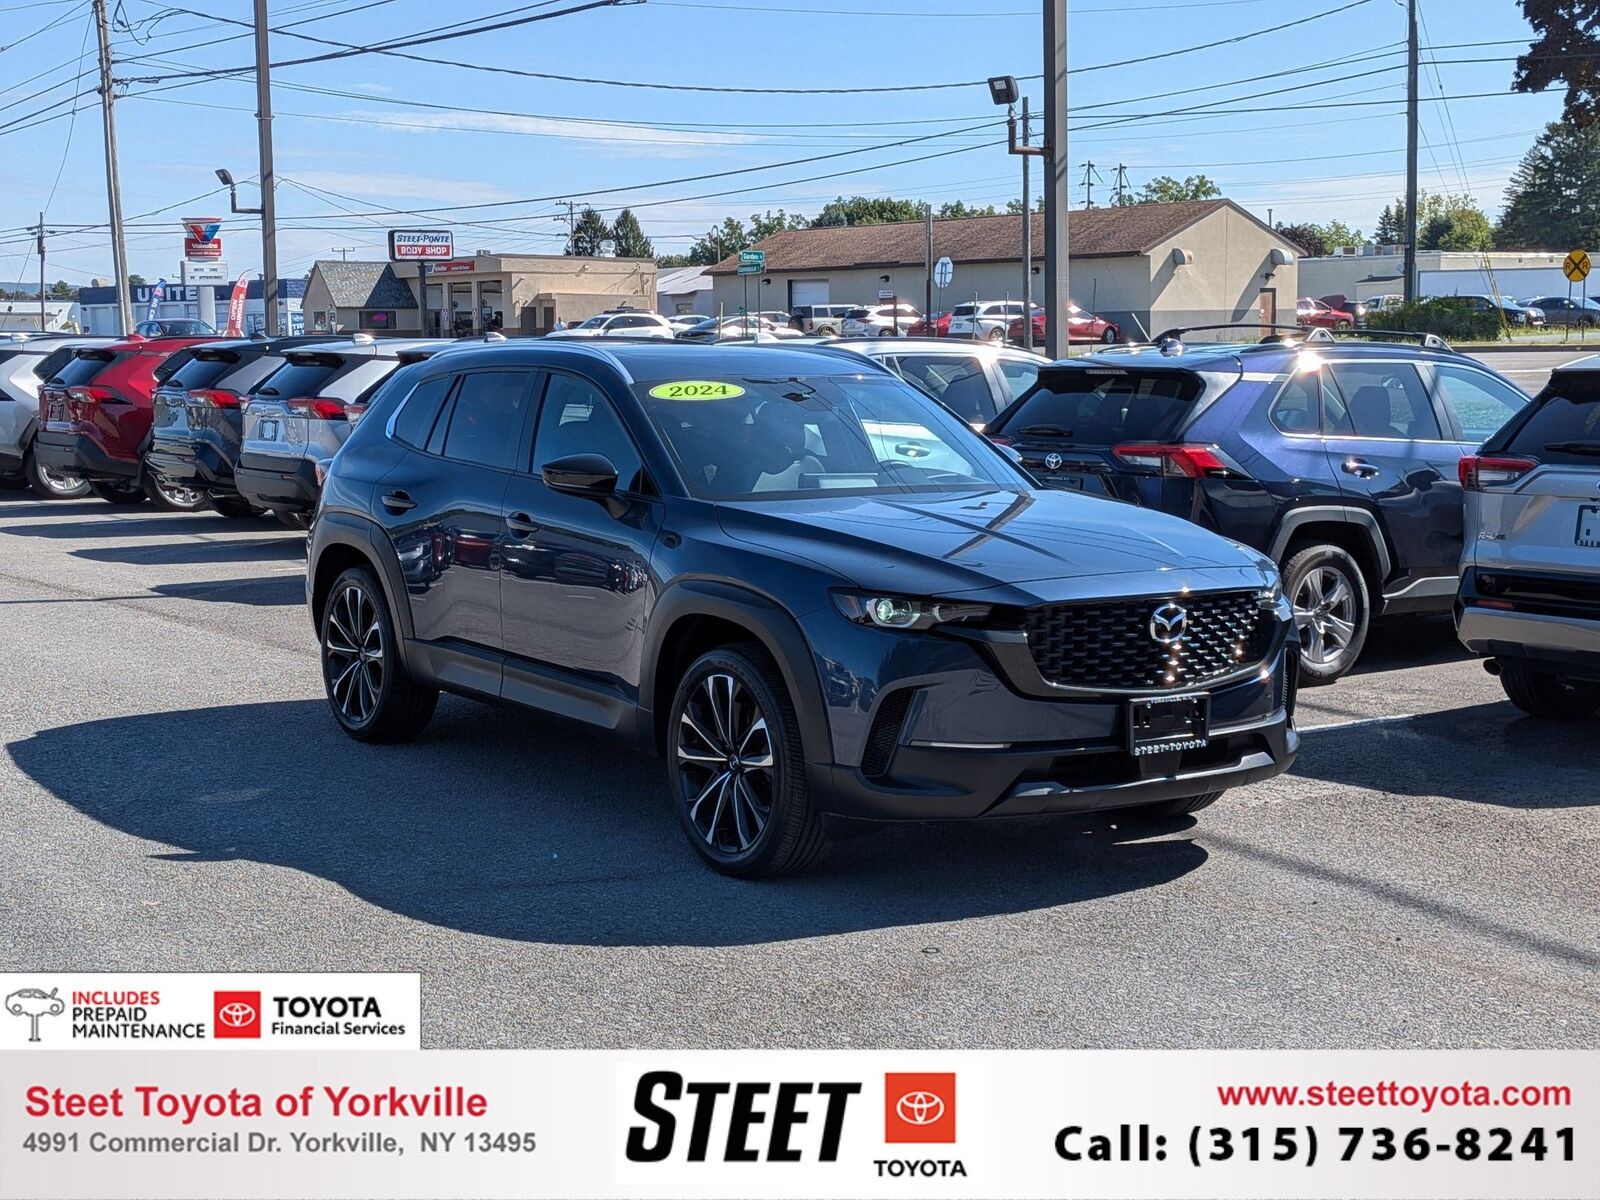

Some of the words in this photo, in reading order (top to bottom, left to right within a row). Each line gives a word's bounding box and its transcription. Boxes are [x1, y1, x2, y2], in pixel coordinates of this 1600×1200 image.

[396, 234, 450, 243] STEET-PONTE
[401, 246, 423, 254] BODY
[425, 246, 447, 254] SHOP
[137, 286, 198, 302] UITE
[235, 293, 246, 329] SUNDAYS
[669, 385, 730, 397] 2024
